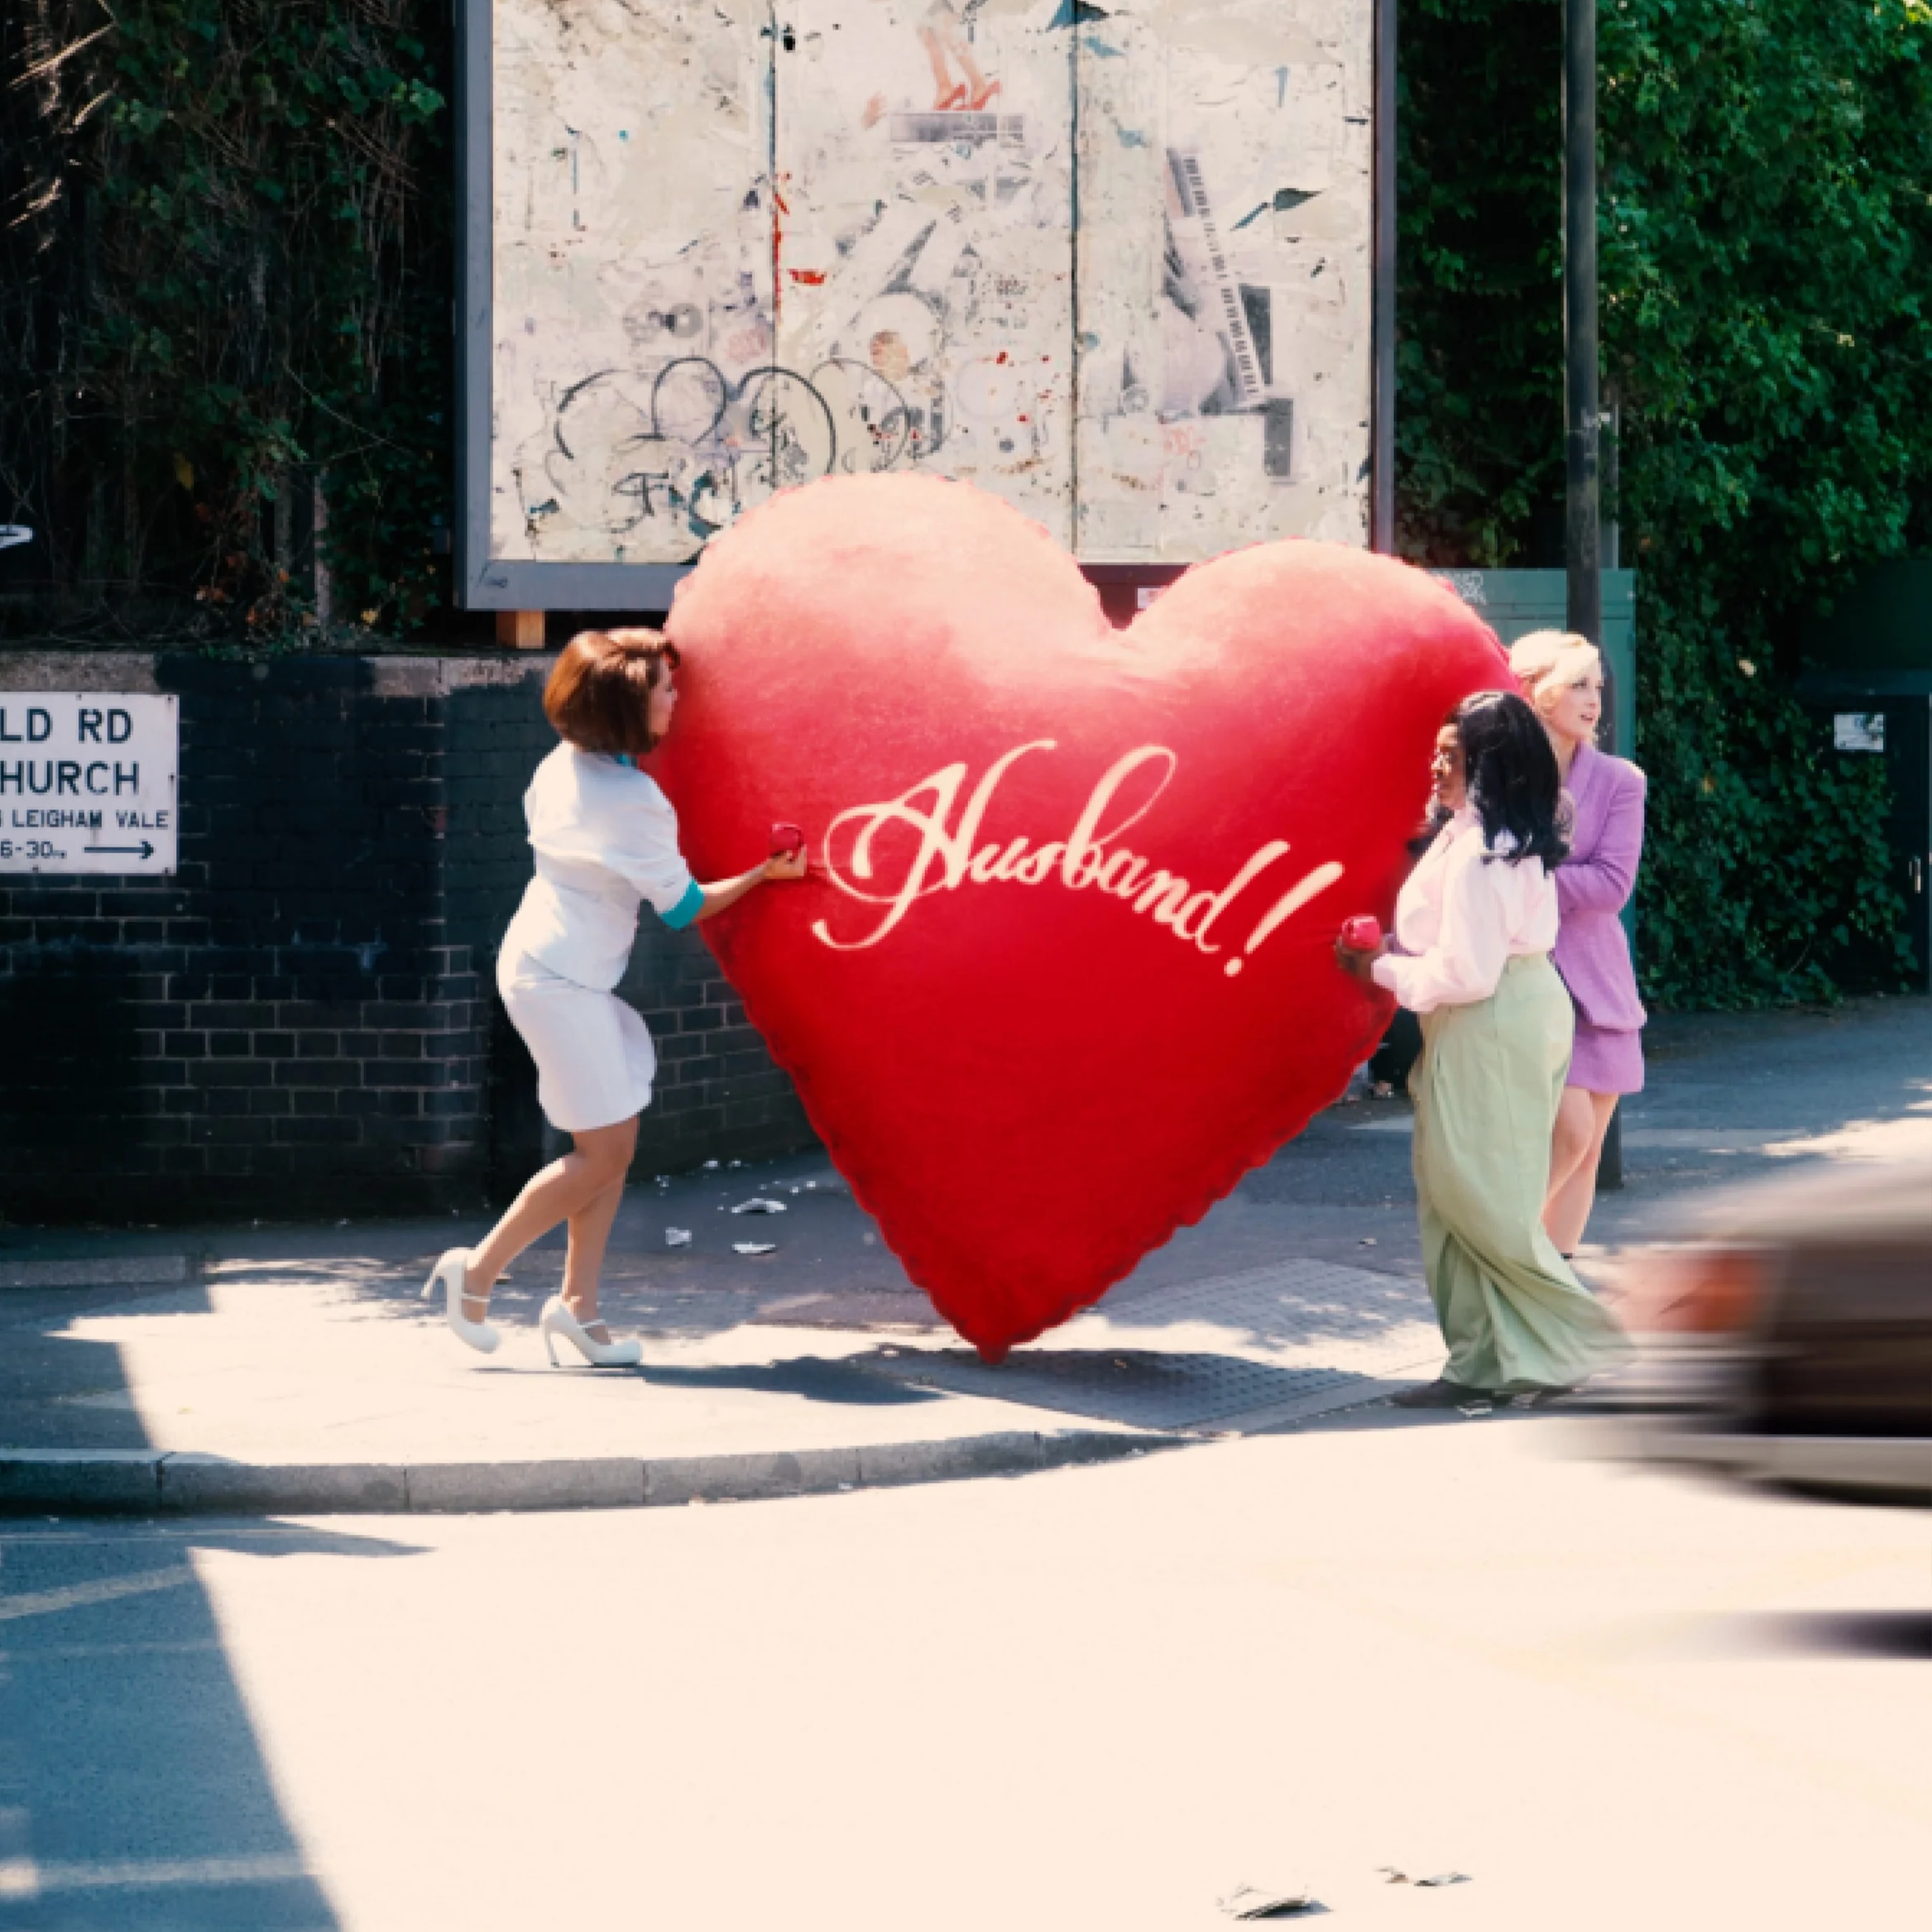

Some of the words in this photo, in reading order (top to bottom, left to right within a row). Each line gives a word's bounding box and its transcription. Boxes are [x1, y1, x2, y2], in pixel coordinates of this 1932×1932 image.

[0, 708, 52, 743] LD
[79, 708, 132, 743] RD
[0, 760, 139, 795] HURCH
[12, 809, 102, 828] LEIGHAM
[116, 809, 169, 829] VALE
[812, 739, 1344, 977] Husband!
